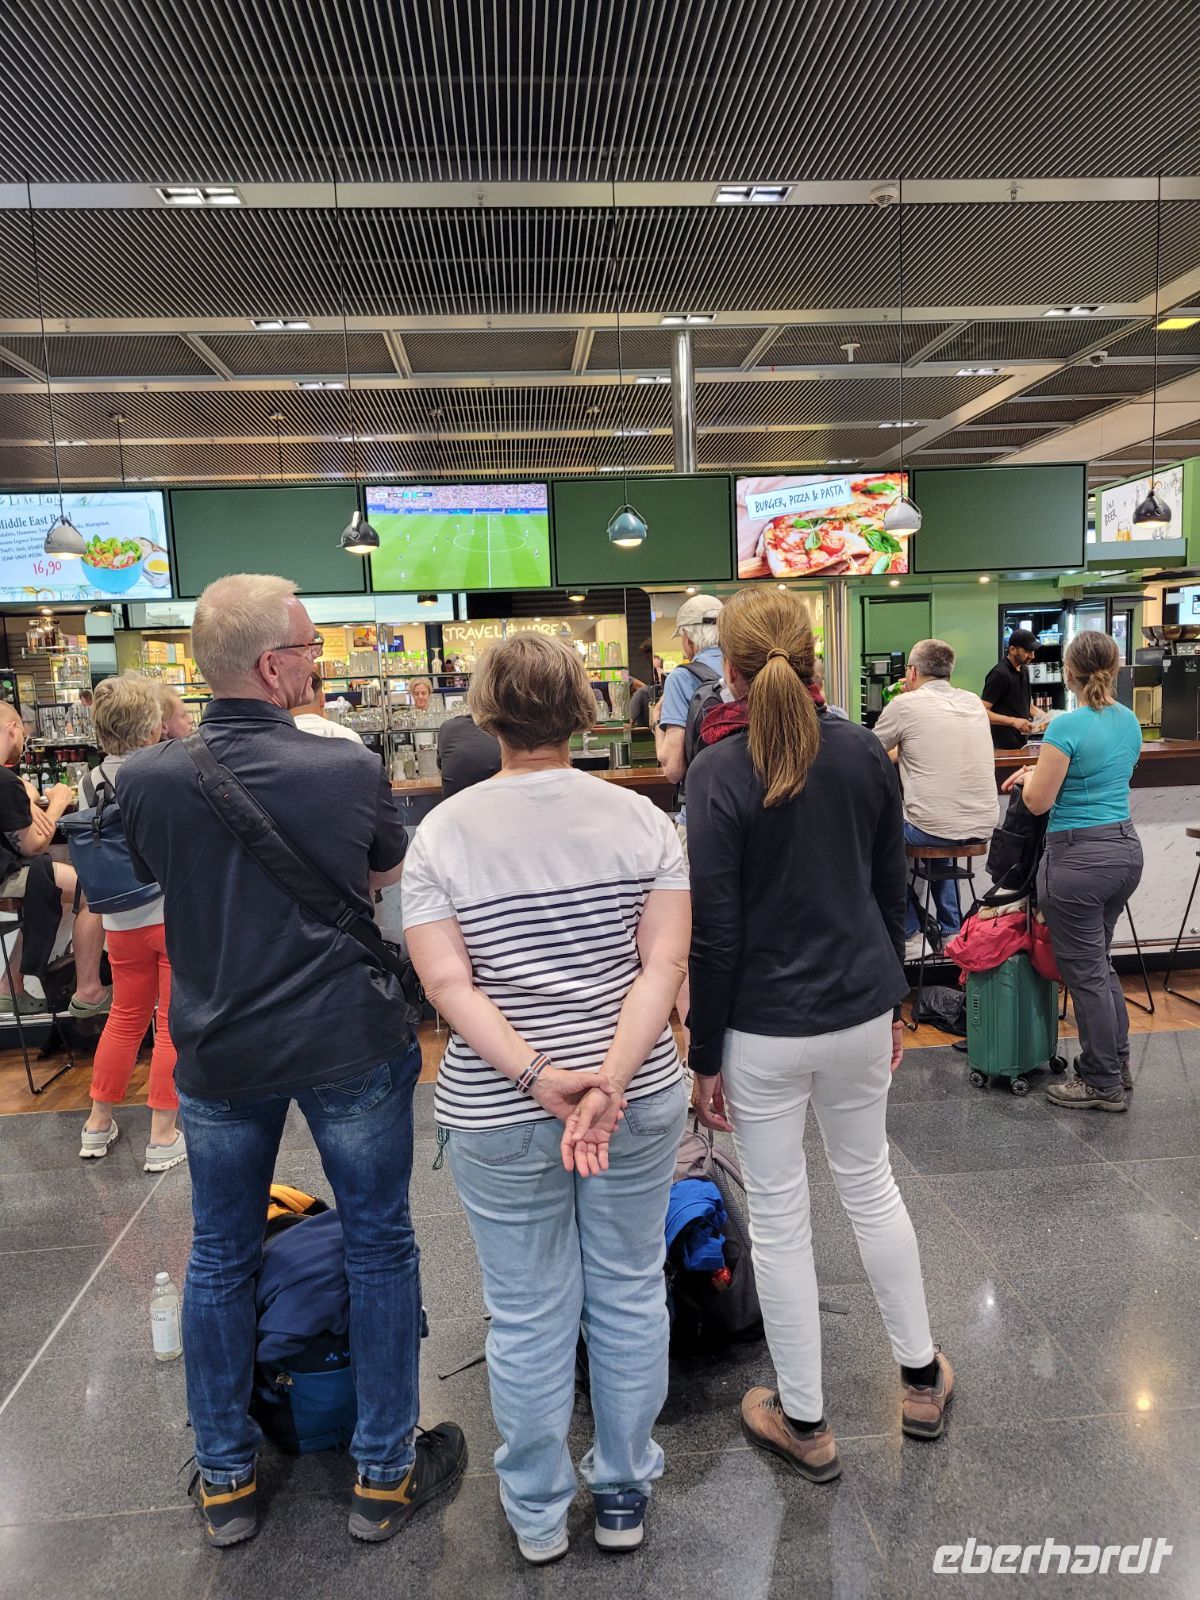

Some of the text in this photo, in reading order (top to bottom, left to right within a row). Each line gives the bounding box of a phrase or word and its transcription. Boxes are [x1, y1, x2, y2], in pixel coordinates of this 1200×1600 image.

[789, 492, 810, 505] PIZZA
[812, 490, 818, 501] &
[820, 484, 844, 499] PASTA
[28, 515, 48, 527] East
[33, 560, 62, 576] 16,90
